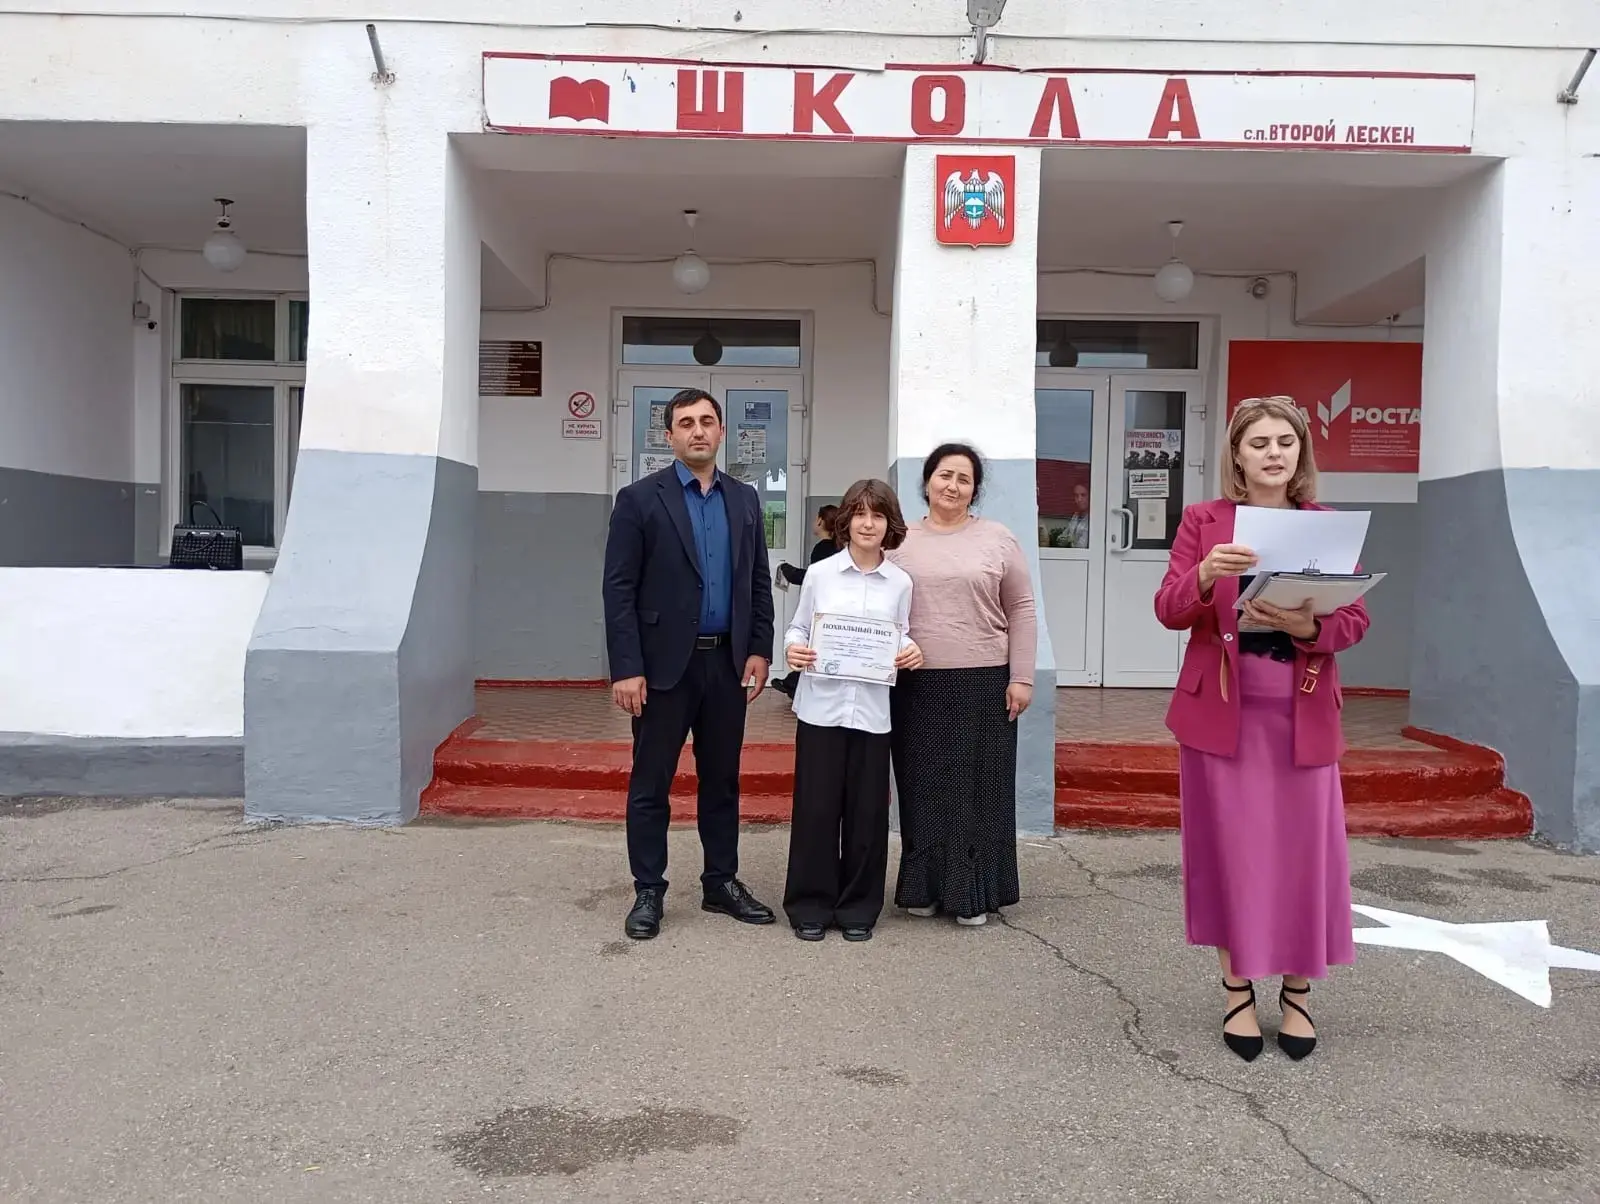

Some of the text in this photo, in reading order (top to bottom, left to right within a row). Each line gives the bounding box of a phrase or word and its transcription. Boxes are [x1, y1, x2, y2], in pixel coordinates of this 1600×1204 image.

[676, 69, 1201, 139] ШКОЛА
[1269, 119, 1336, 142] ВТОРОЙ
[1345, 125, 1415, 144] ЛЕСКЕН
[1350, 407, 1420, 424] РОСТА
[822, 623, 893, 637] ПОХВАЛЬНЫЙ ЛИСТ
